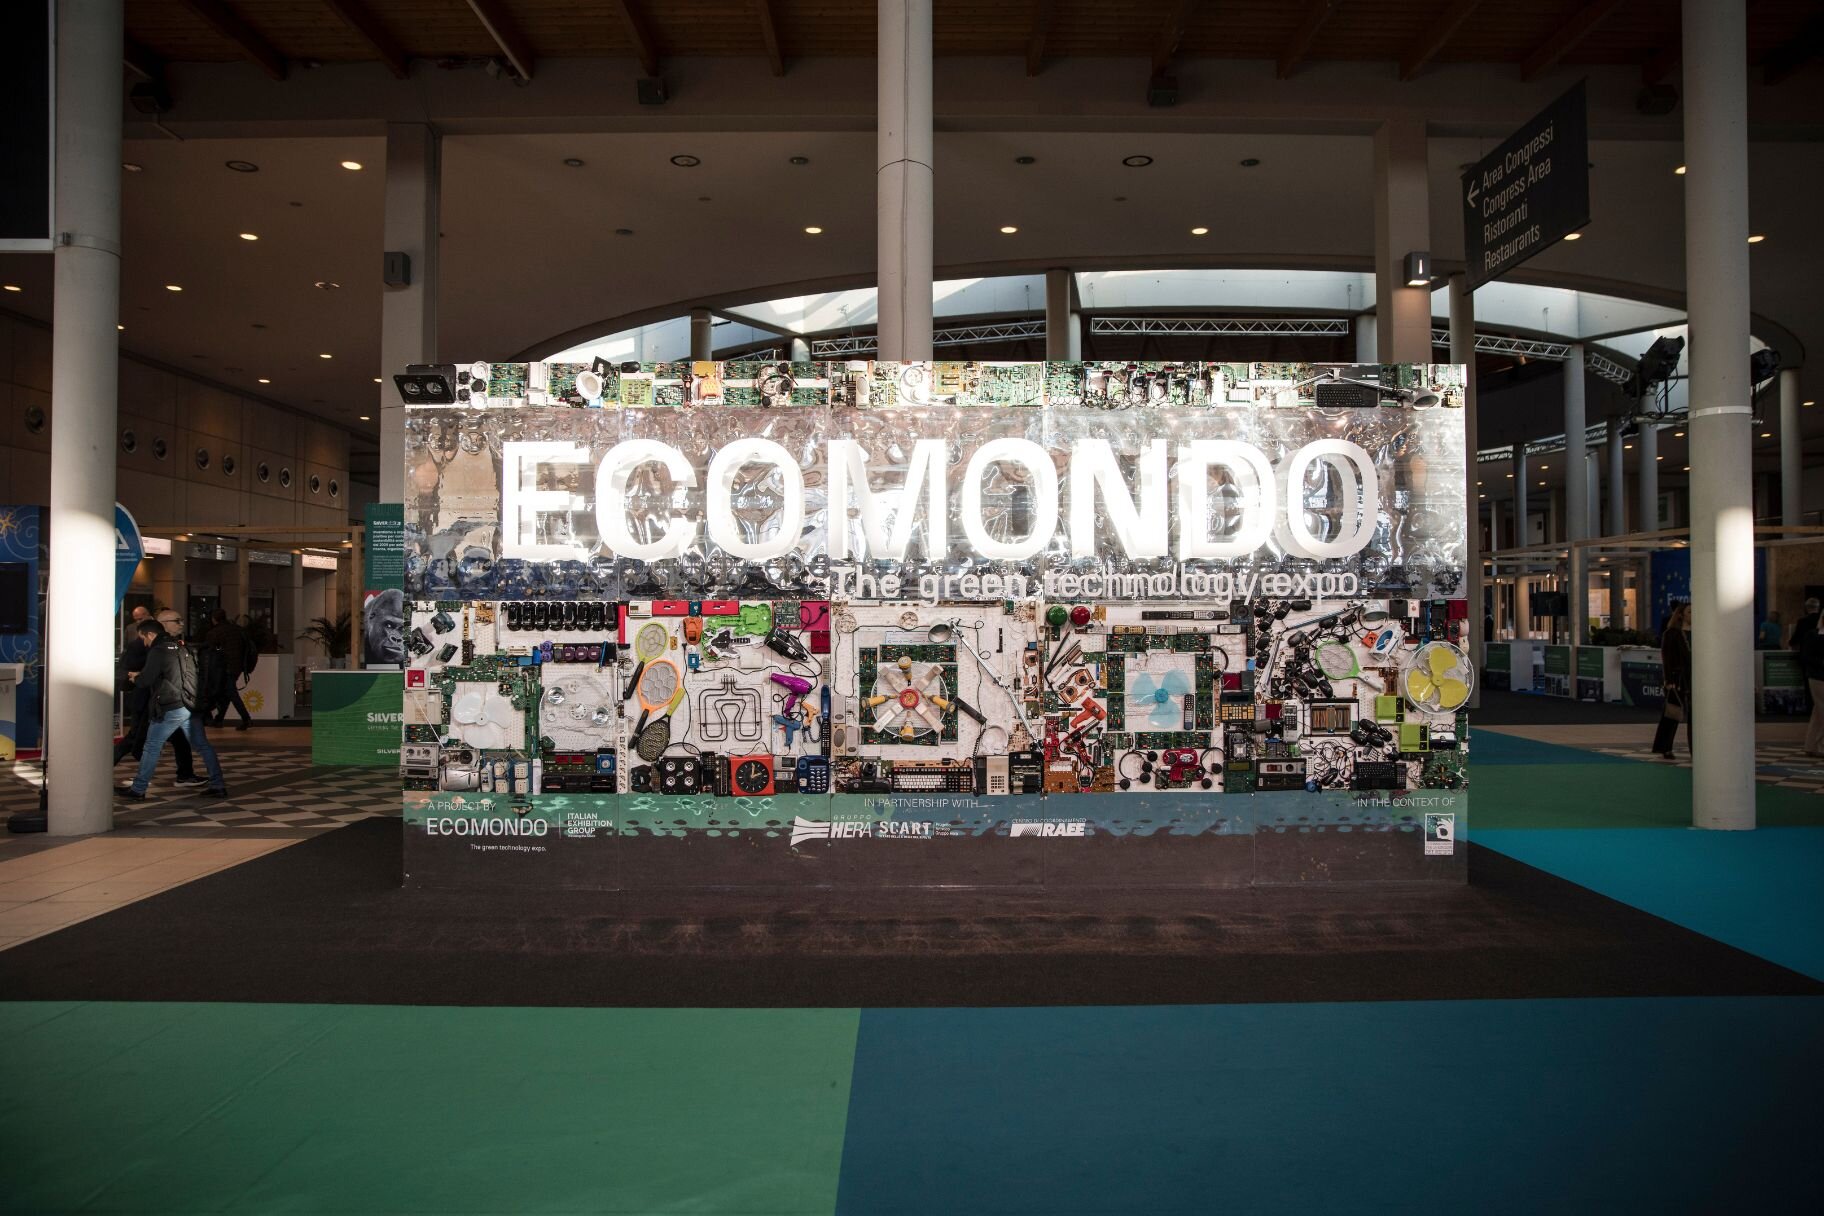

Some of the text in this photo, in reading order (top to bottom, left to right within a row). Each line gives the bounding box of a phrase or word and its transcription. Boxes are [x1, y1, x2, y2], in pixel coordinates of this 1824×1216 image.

[1482, 120, 1554, 192] Area Congressi
[1483, 158, 1551, 218] Congress Area
[1484, 198, 1528, 245] Ristoranti
[1484, 224, 1540, 272] Restaurants
[502, 437, 1379, 562] ECOMONDO
[829, 562, 1368, 607] The green technology expo.
[428, 802, 497, 811] A PROJECT BY
[864, 798, 978, 808] IN PARTNERSHIP WITH
[1357, 797, 1456, 807] IN THE CONTEXT OF
[567, 812, 598, 820] ITALIAN
[426, 817, 548, 836] ECOMONDO
[830, 821, 872, 839] HERA
[879, 821, 932, 835] SCART
[1042, 822, 1086, 837] RAEE
[499, 844, 530, 852] technology
